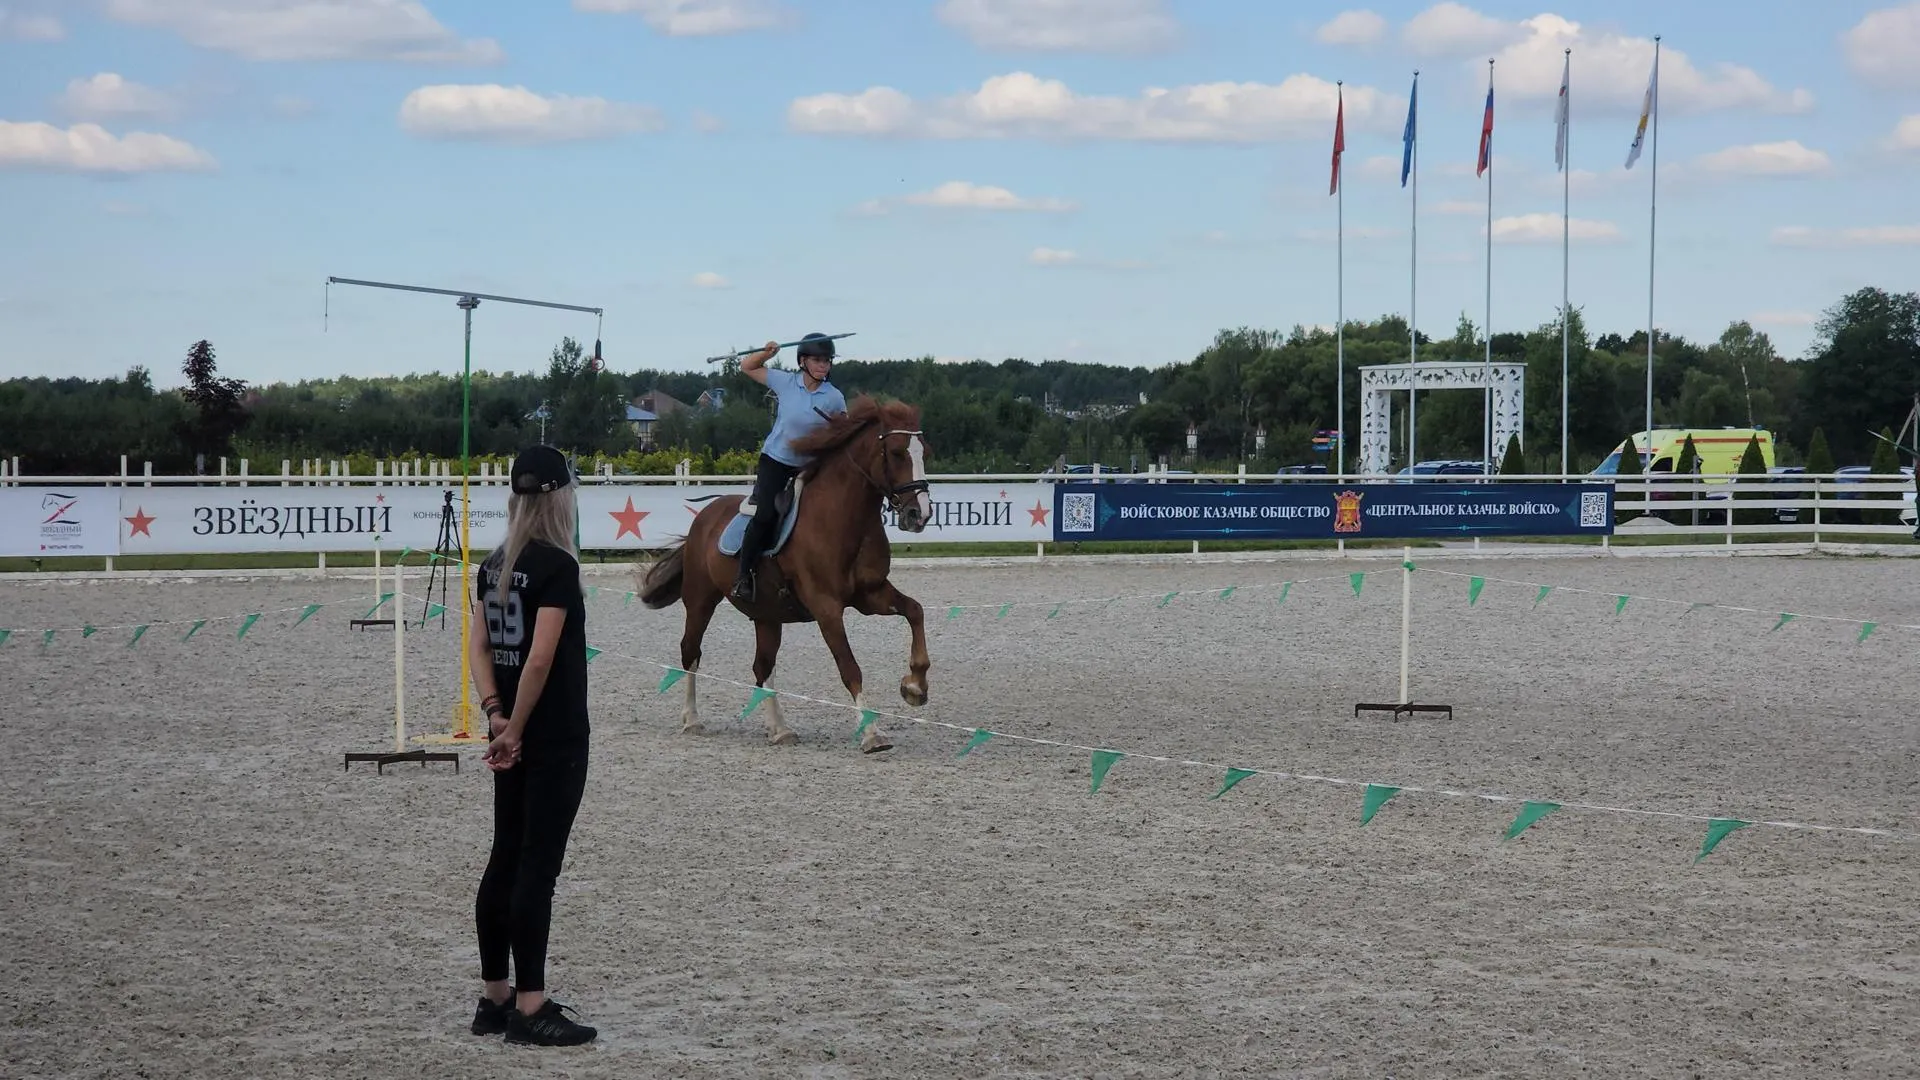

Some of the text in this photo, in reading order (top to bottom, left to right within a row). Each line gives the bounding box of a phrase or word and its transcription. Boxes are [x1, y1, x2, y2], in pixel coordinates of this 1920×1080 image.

[192, 498, 393, 539] ЗВЁЗДНЫЙ
[1120, 504, 1331, 519] ВОЙСКОВОЕ КАЗАЧЬЕ ОБЩЕСТВО
[1365, 501, 1561, 517] «ЦЕНТРАЛЬНОЕ КАЗАЧЬЕ ВОЙСКО»
[483, 589, 525, 646] 69
